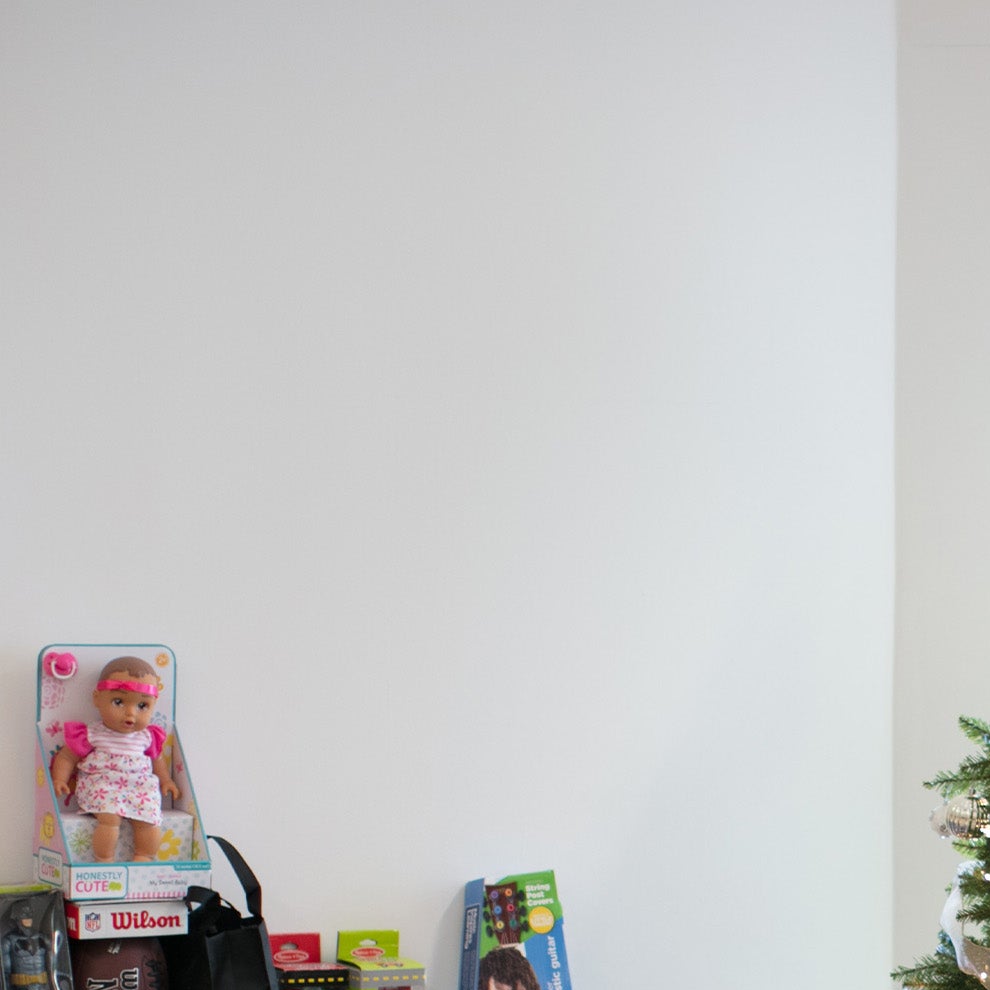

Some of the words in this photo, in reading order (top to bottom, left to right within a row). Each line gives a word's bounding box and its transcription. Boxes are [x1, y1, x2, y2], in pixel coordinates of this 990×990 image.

[76, 872, 122, 880] HONESTLY
[76, 881, 108, 892] CUTE
[527, 898, 554, 907] Covers
[111, 910, 181, 930] Wilson
[547, 936, 560, 970] guitar
